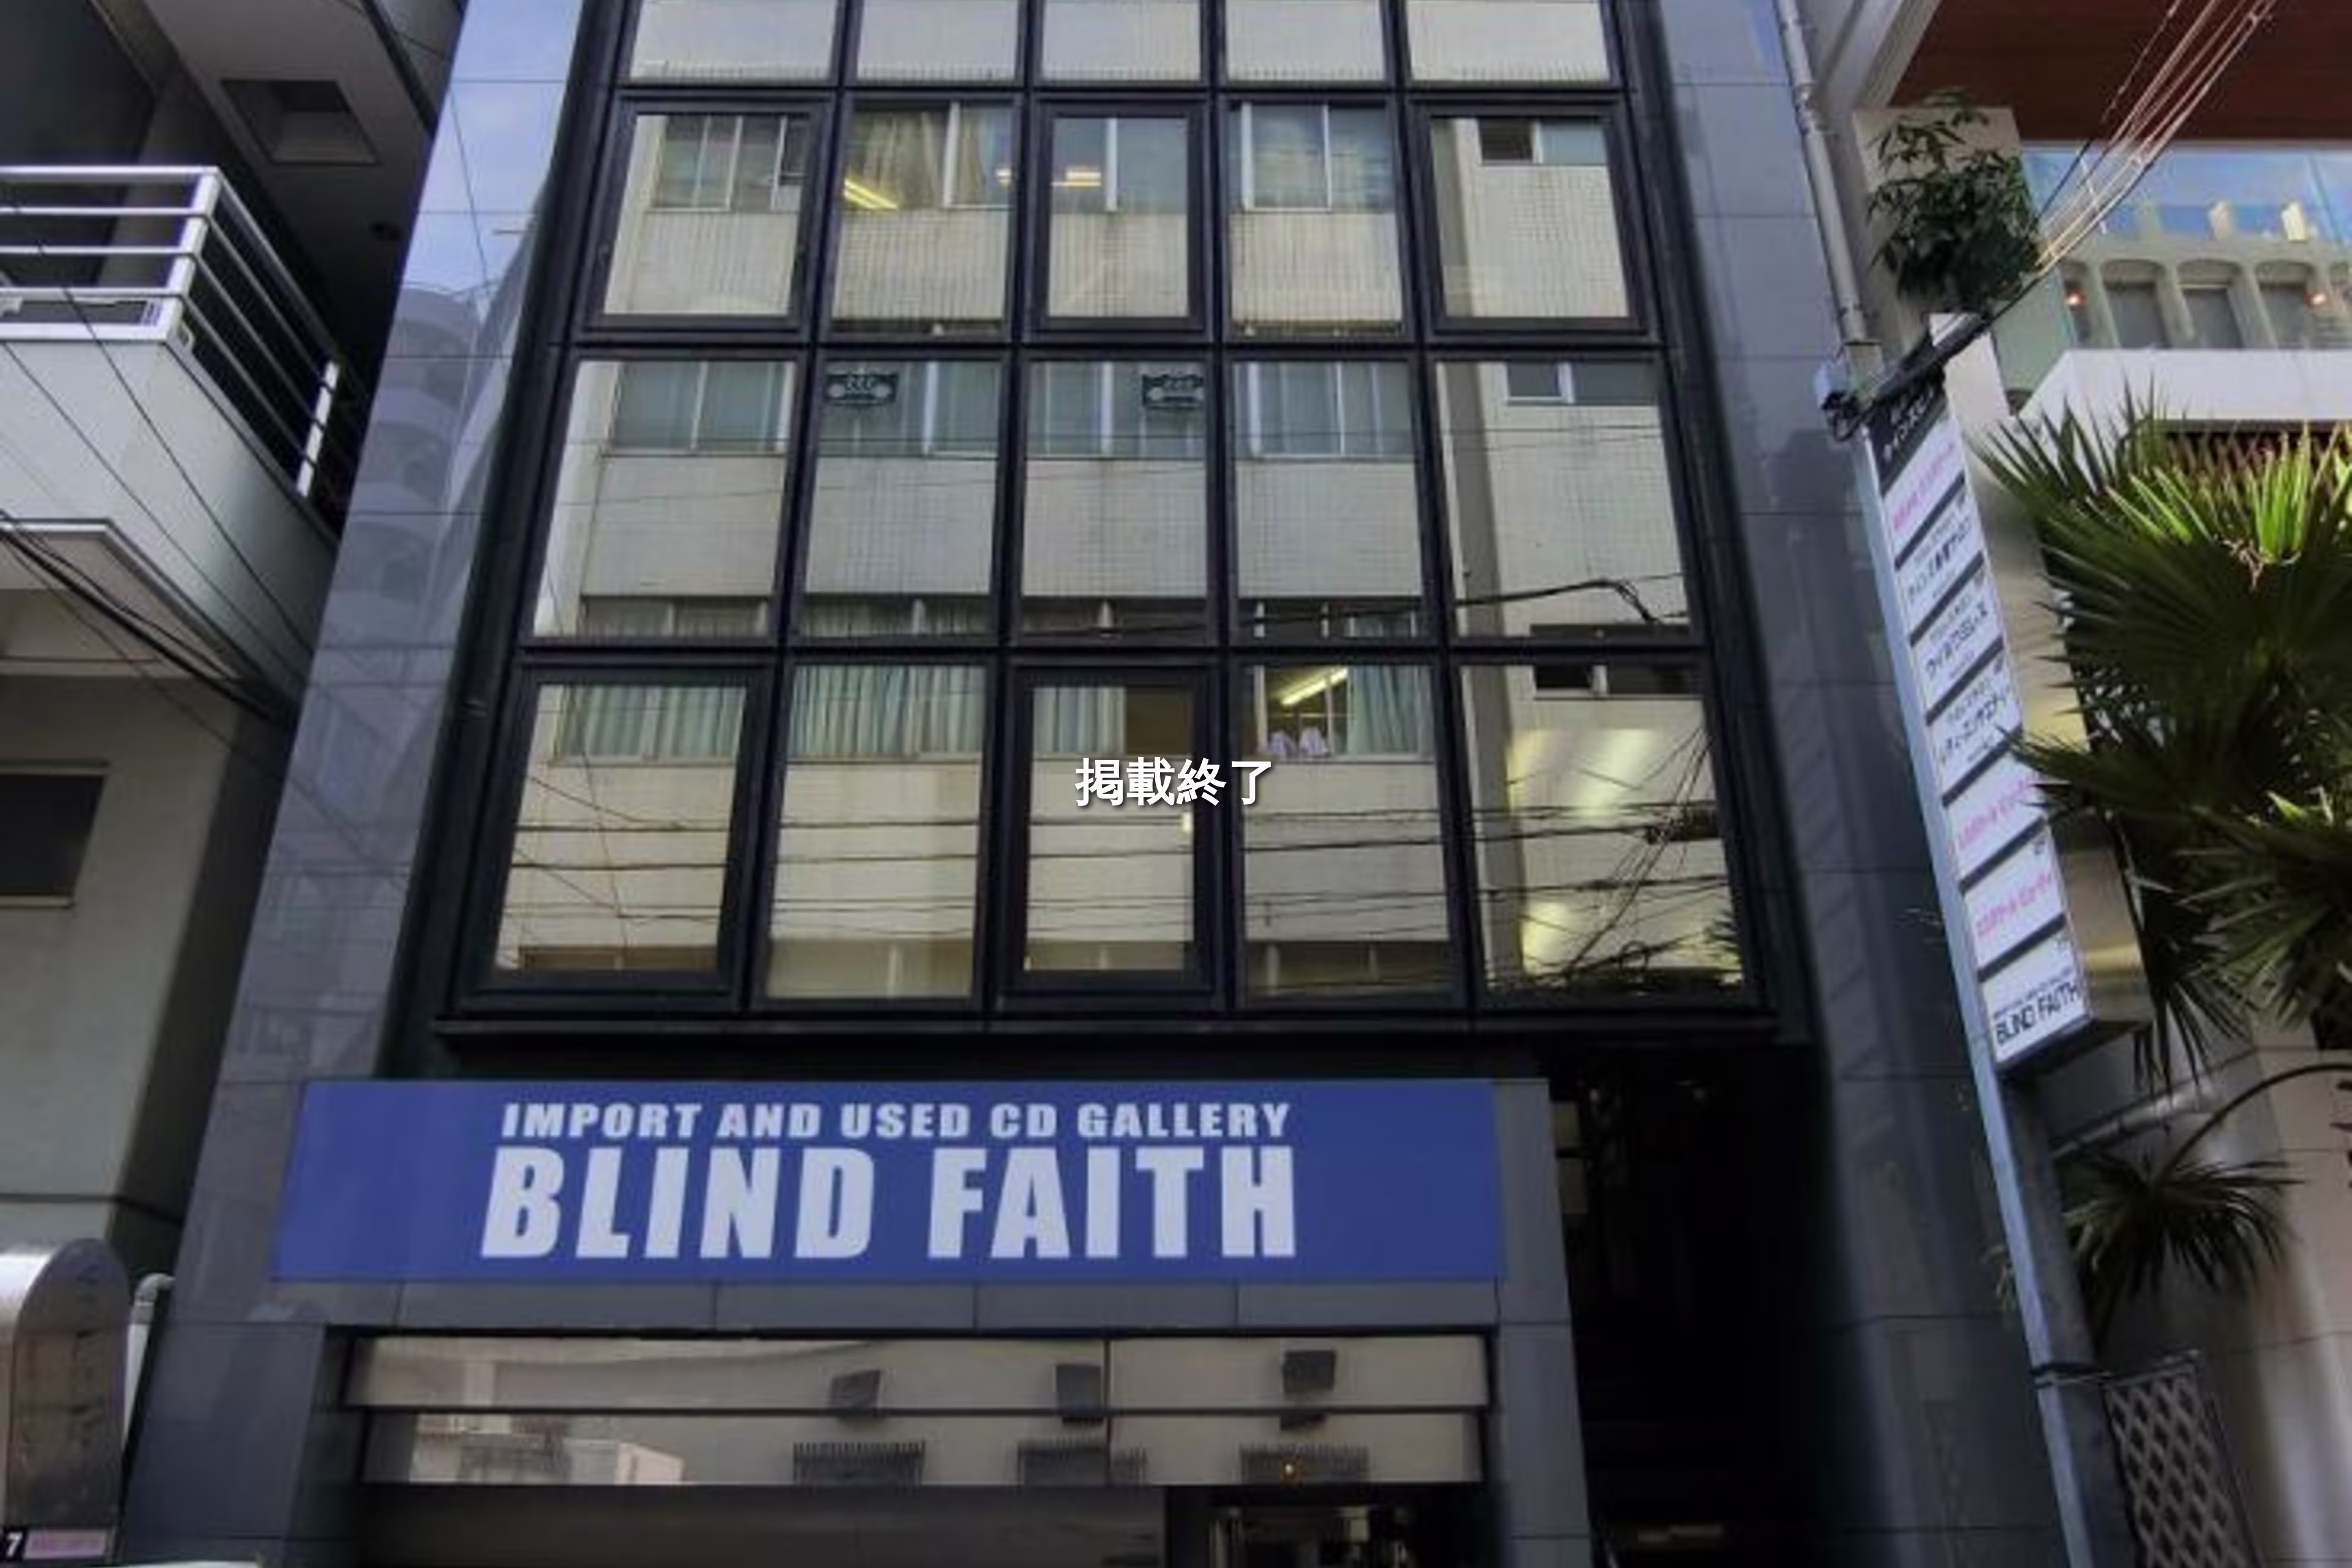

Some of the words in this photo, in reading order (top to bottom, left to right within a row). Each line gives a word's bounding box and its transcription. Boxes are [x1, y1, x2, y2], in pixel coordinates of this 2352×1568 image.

[1996, 1005, 2037, 1046] BLIND
[2037, 981, 2079, 1021] FAITH
[501, 1102, 703, 1139] IMPORT
[716, 1102, 821, 1138] AND
[840, 1102, 970, 1139] USED
[990, 1102, 1057, 1139] CD
[1077, 1102, 1290, 1138] GALLERY
[481, 1146, 875, 1258] BLIND
[928, 1146, 1295, 1258] FAITH
